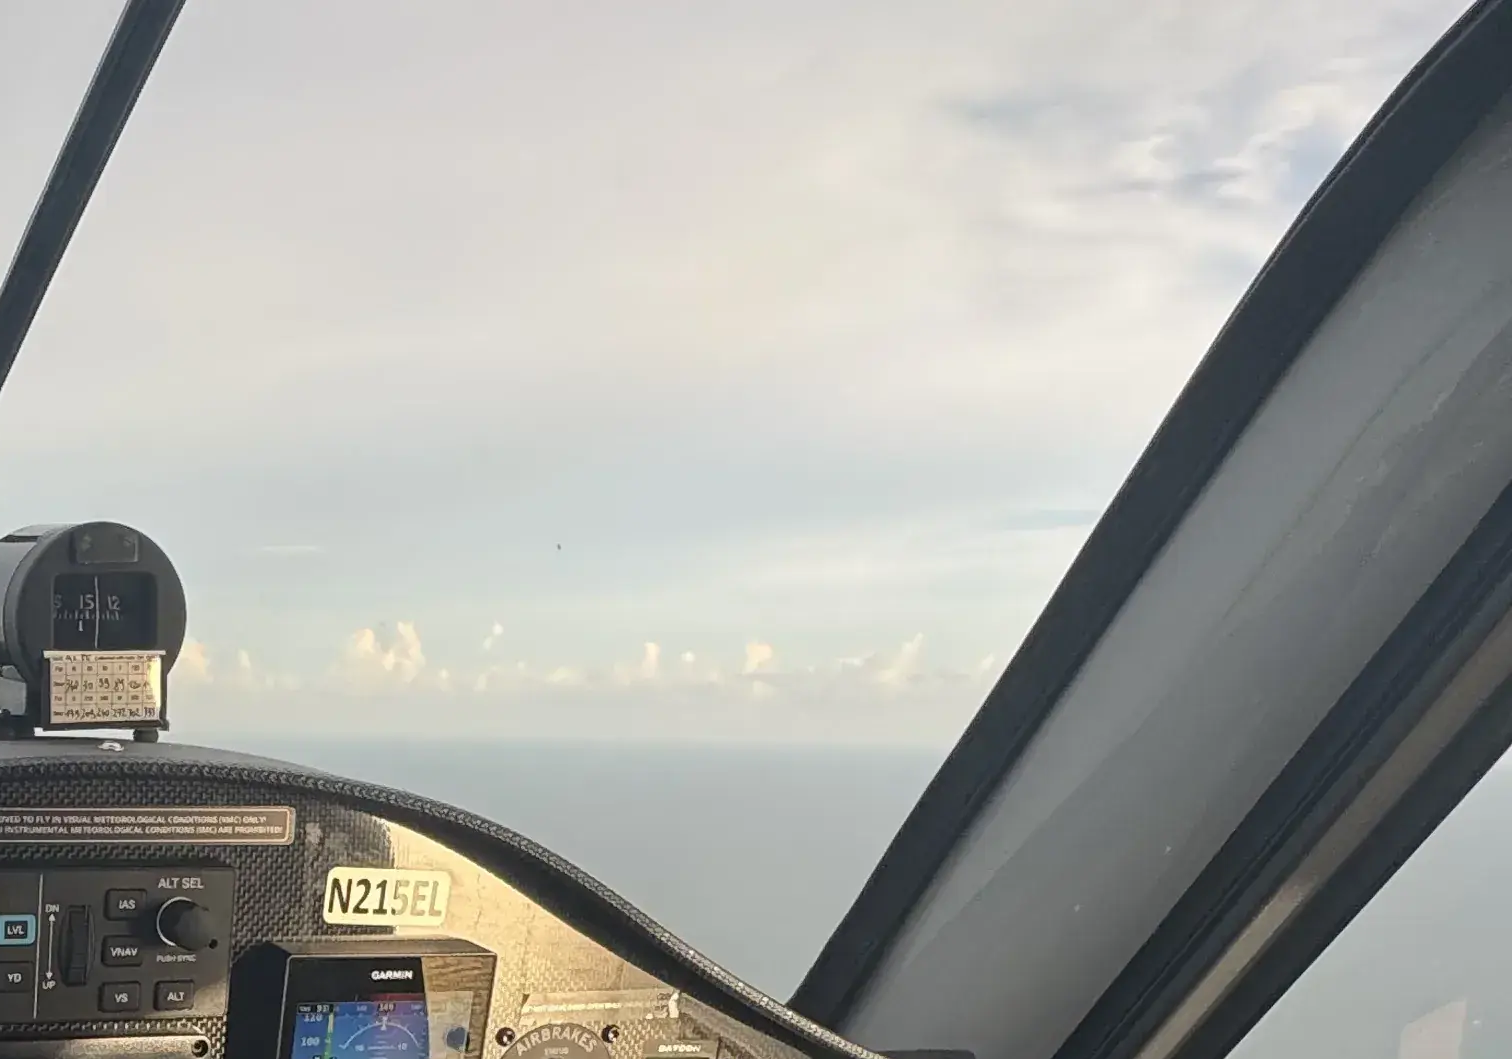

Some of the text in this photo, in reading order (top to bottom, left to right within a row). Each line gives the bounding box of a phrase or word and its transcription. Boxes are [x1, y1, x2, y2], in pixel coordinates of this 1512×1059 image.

[145, 826, 195, 834] CONDITIONS
[158, 878, 204, 889] ALT SEL
[328, 877, 442, 917] N215EL
[45, 903, 59, 913] DN
[118, 899, 136, 910] IAS
[7, 925, 25, 935] LVL
[110, 947, 138, 956] VNAV
[8, 973, 22, 982] YD
[371, 969, 413, 980] GARMIN
[42, 981, 56, 990] UP
[115, 993, 128, 1002] VS
[167, 991, 184, 1001] ALT
[515, 1026, 598, 1056] AIRBRAKES
